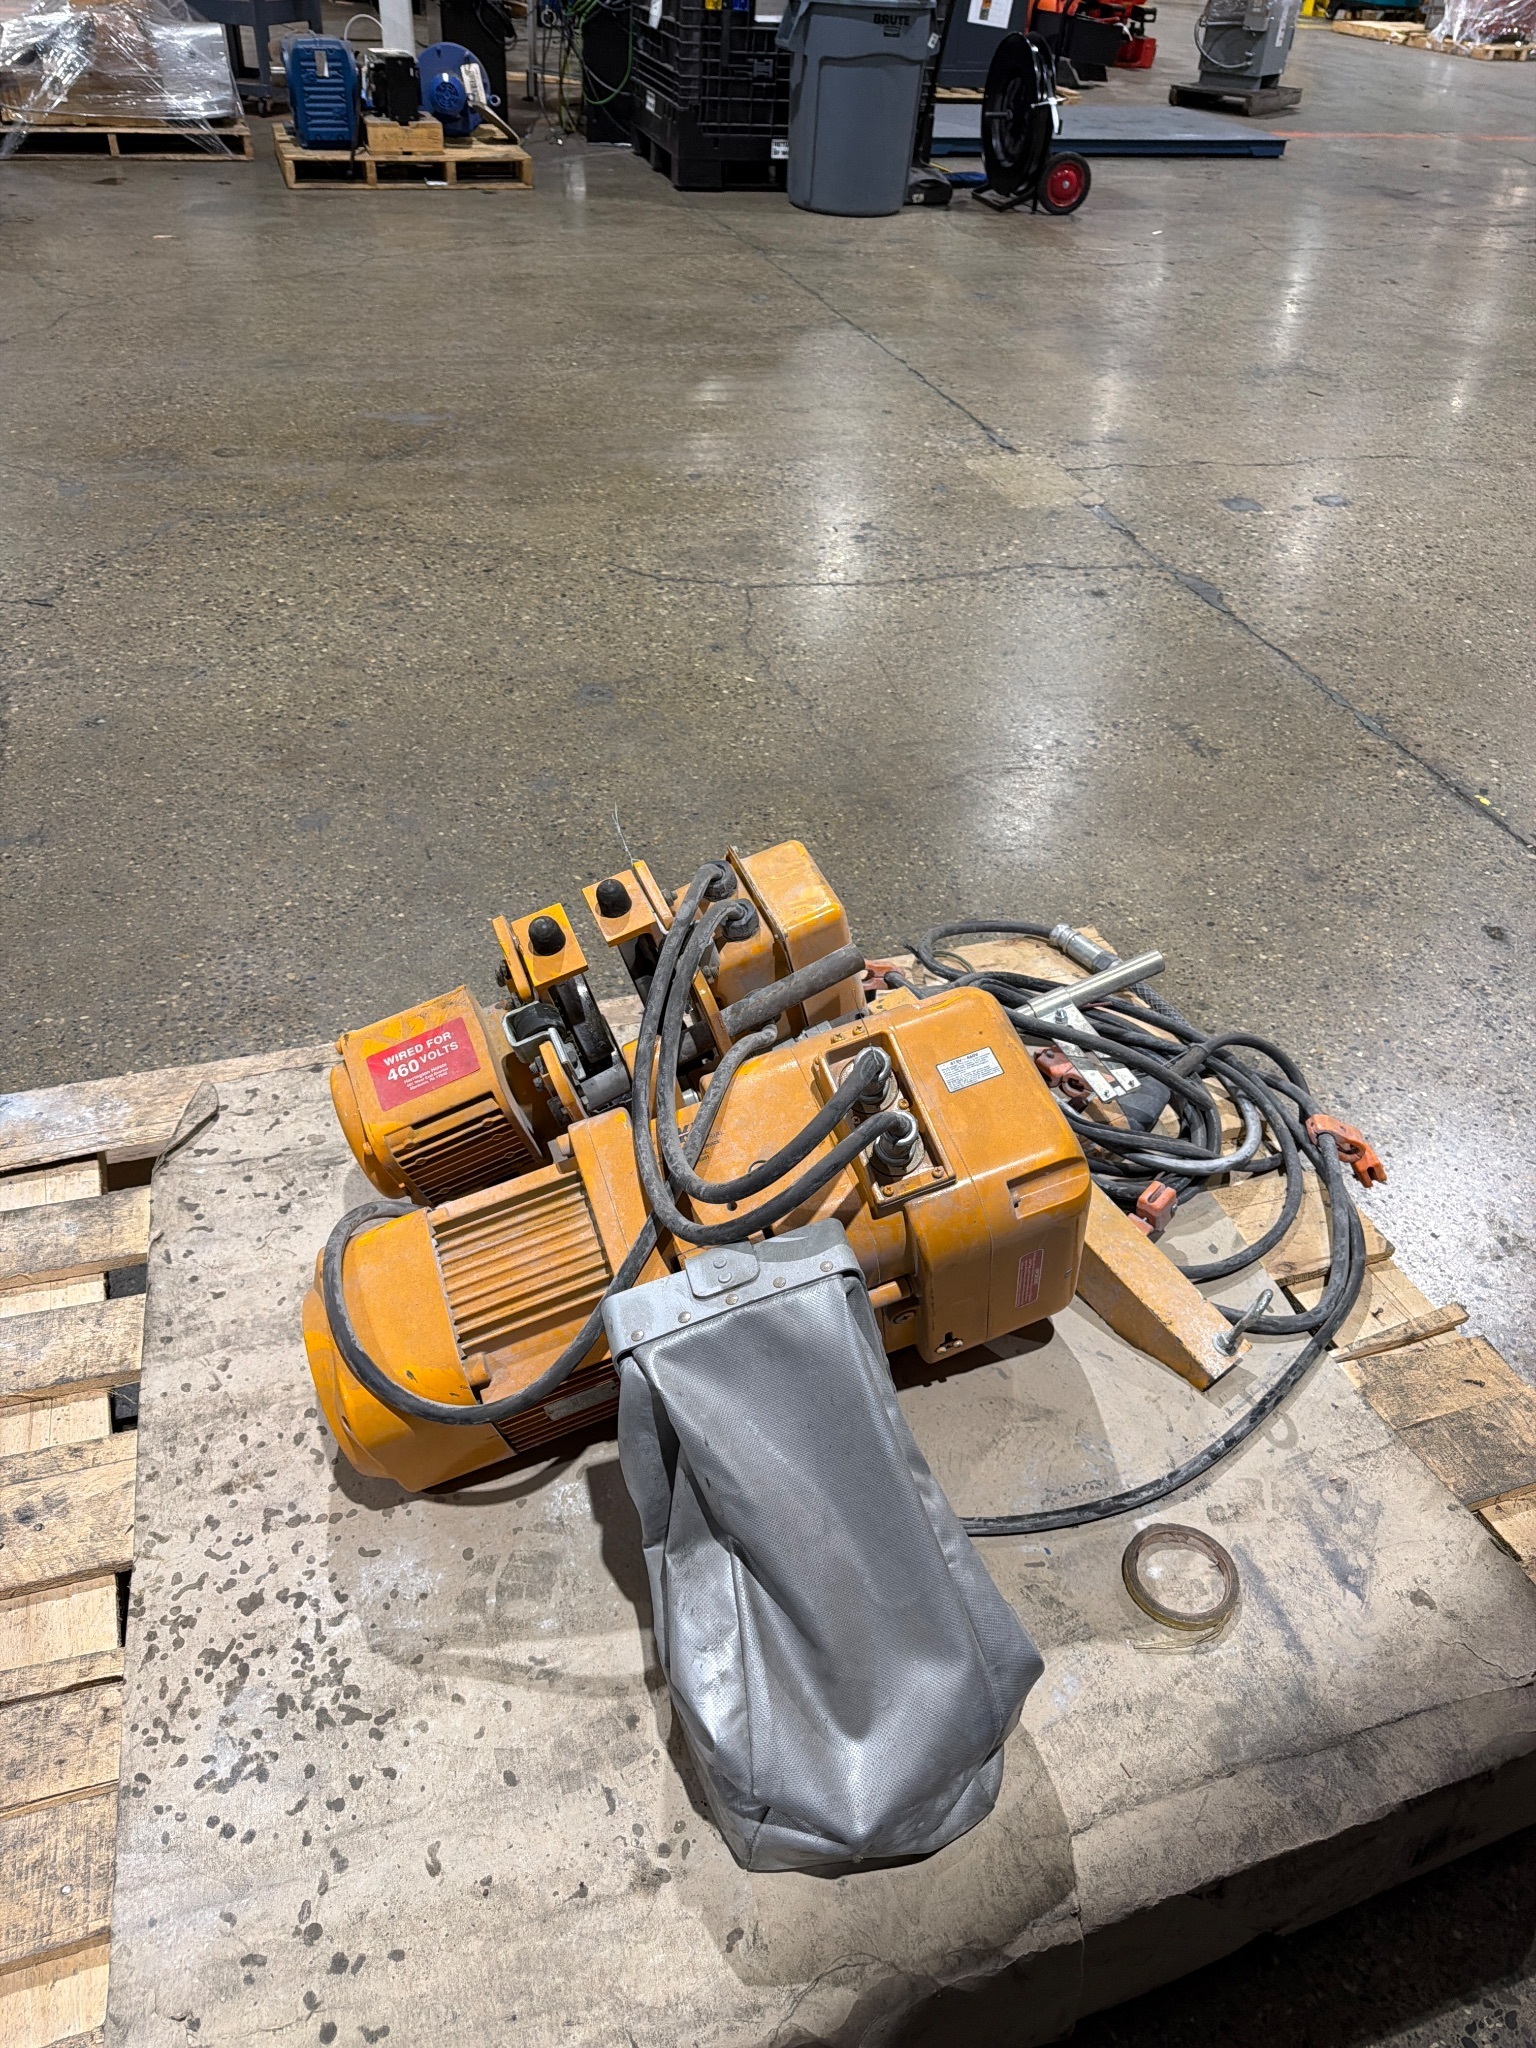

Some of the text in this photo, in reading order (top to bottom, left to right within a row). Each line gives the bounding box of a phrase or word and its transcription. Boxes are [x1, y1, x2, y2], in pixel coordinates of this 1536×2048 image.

[873, 14, 910, 25] BRUTE
[383, 1031, 452, 1066] WIRED FOR
[387, 1041, 458, 1081] 460 VOLTS
[403, 1070, 430, 1084] Harrington
